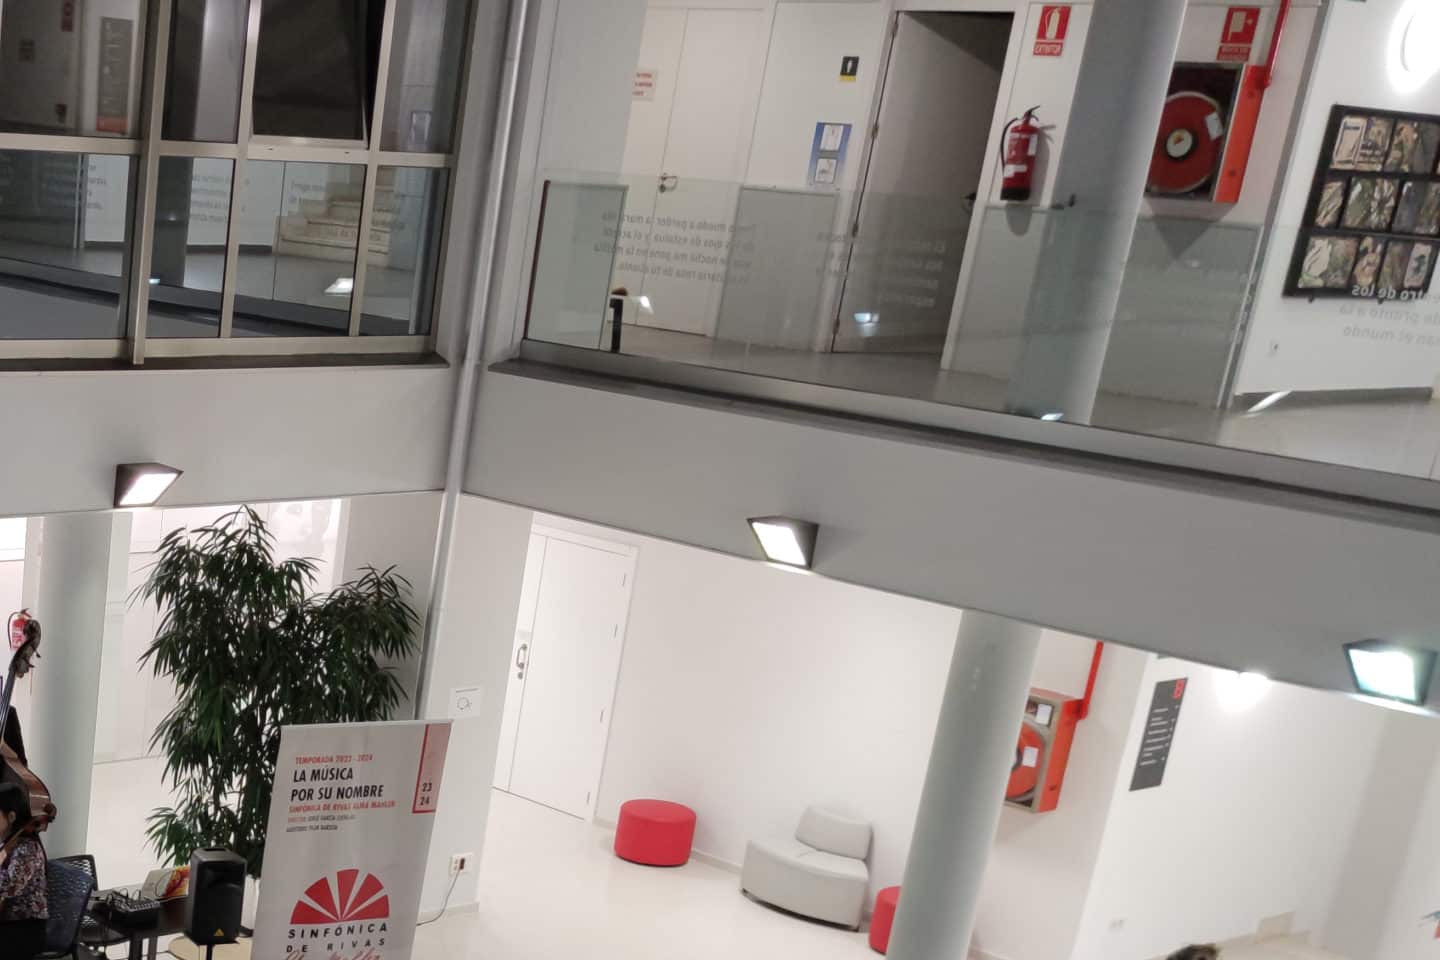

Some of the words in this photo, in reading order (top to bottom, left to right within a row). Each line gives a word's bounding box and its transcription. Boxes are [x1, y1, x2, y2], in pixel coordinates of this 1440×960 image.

[293, 769, 306, 783] LA
[310, 765, 353, 782] MÚSICA
[291, 788, 314, 802] POR
[318, 786, 332, 800] SU
[336, 784, 384, 799] NOMBRE
[286, 944, 309, 953] DE
[327, 938, 385, 951] RIVAS
